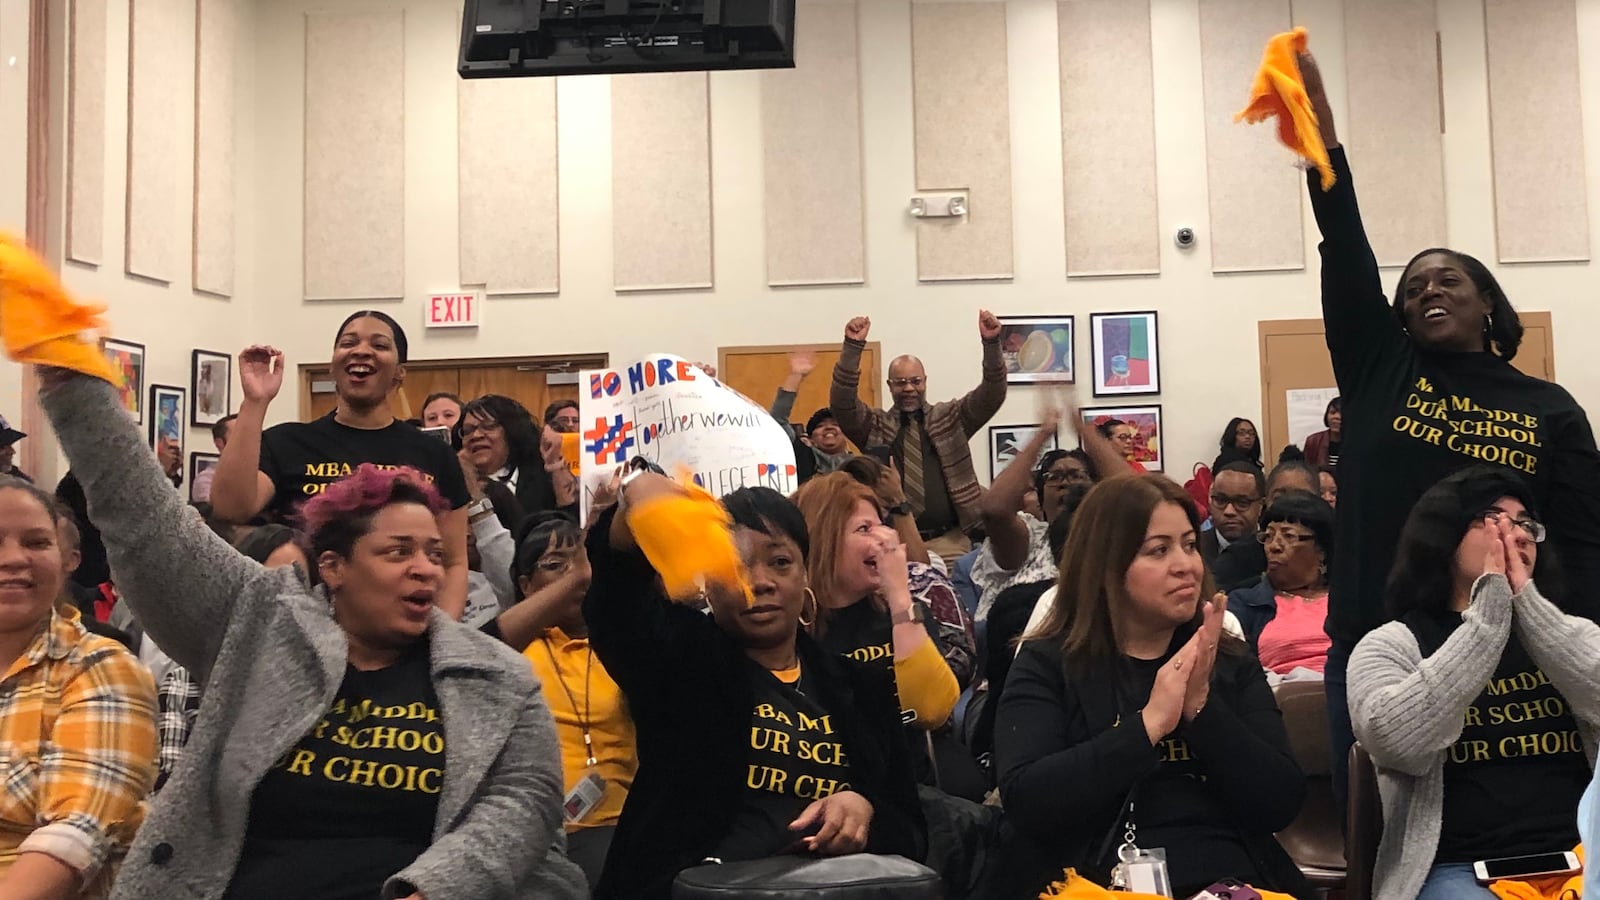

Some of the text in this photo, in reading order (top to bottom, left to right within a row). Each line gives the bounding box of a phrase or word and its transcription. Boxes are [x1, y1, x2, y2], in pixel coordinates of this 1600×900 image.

[431, 296, 474, 322] EXIT
[590, 359, 695, 400] 10 MORE
[1392, 415, 1538, 475] OUR CHOICE
[1448, 418, 1542, 448] SCHOOL
[304, 462, 352, 477] MBA
[757, 463, 797, 494] PREP
[347, 699, 439, 724] MIDDL
[752, 703, 794, 727] BA
[1488, 697, 1564, 725] SCHO
[331, 726, 444, 755] SCHOO
[750, 726, 850, 768] UR SCH
[1451, 731, 1584, 764] UR CHOIC
[323, 756, 444, 794] CHOIC
[746, 764, 788, 795] UR
